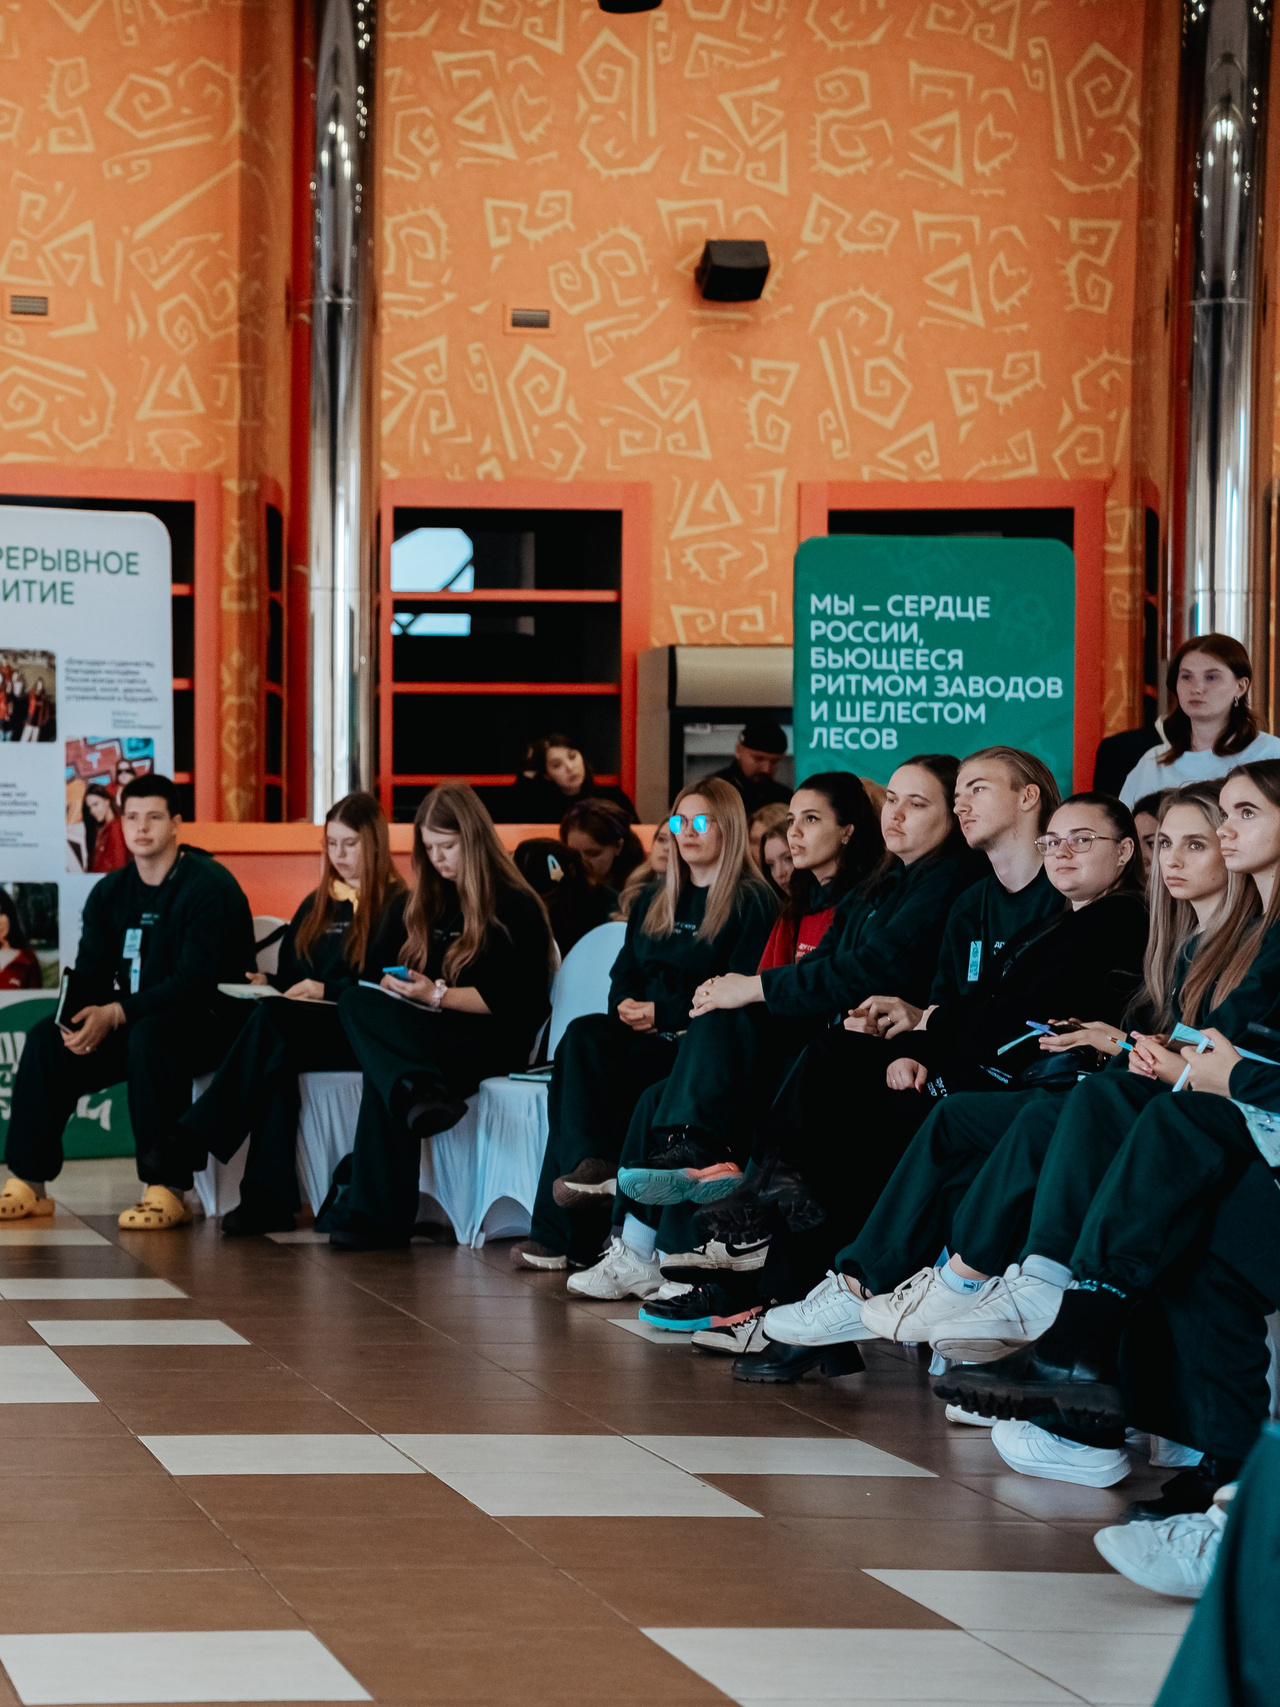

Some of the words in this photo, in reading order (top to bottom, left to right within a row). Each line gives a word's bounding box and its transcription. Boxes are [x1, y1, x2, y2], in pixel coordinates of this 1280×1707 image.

[810, 593, 855, 616] МЫ
[886, 594, 991, 621] СЕРДЦЕ
[810, 620, 924, 647] РОССИИ,
[810, 646, 964, 673] БЬЮЩЕЕСЯ
[810, 673, 927, 696] РИТМОМ
[933, 675, 1064, 702] ЗАВОДОВ
[810, 700, 828, 722] И
[835, 701, 986, 724] ШЕЛЕСТОМ
[809, 727, 898, 750] ЛЕСОВ
